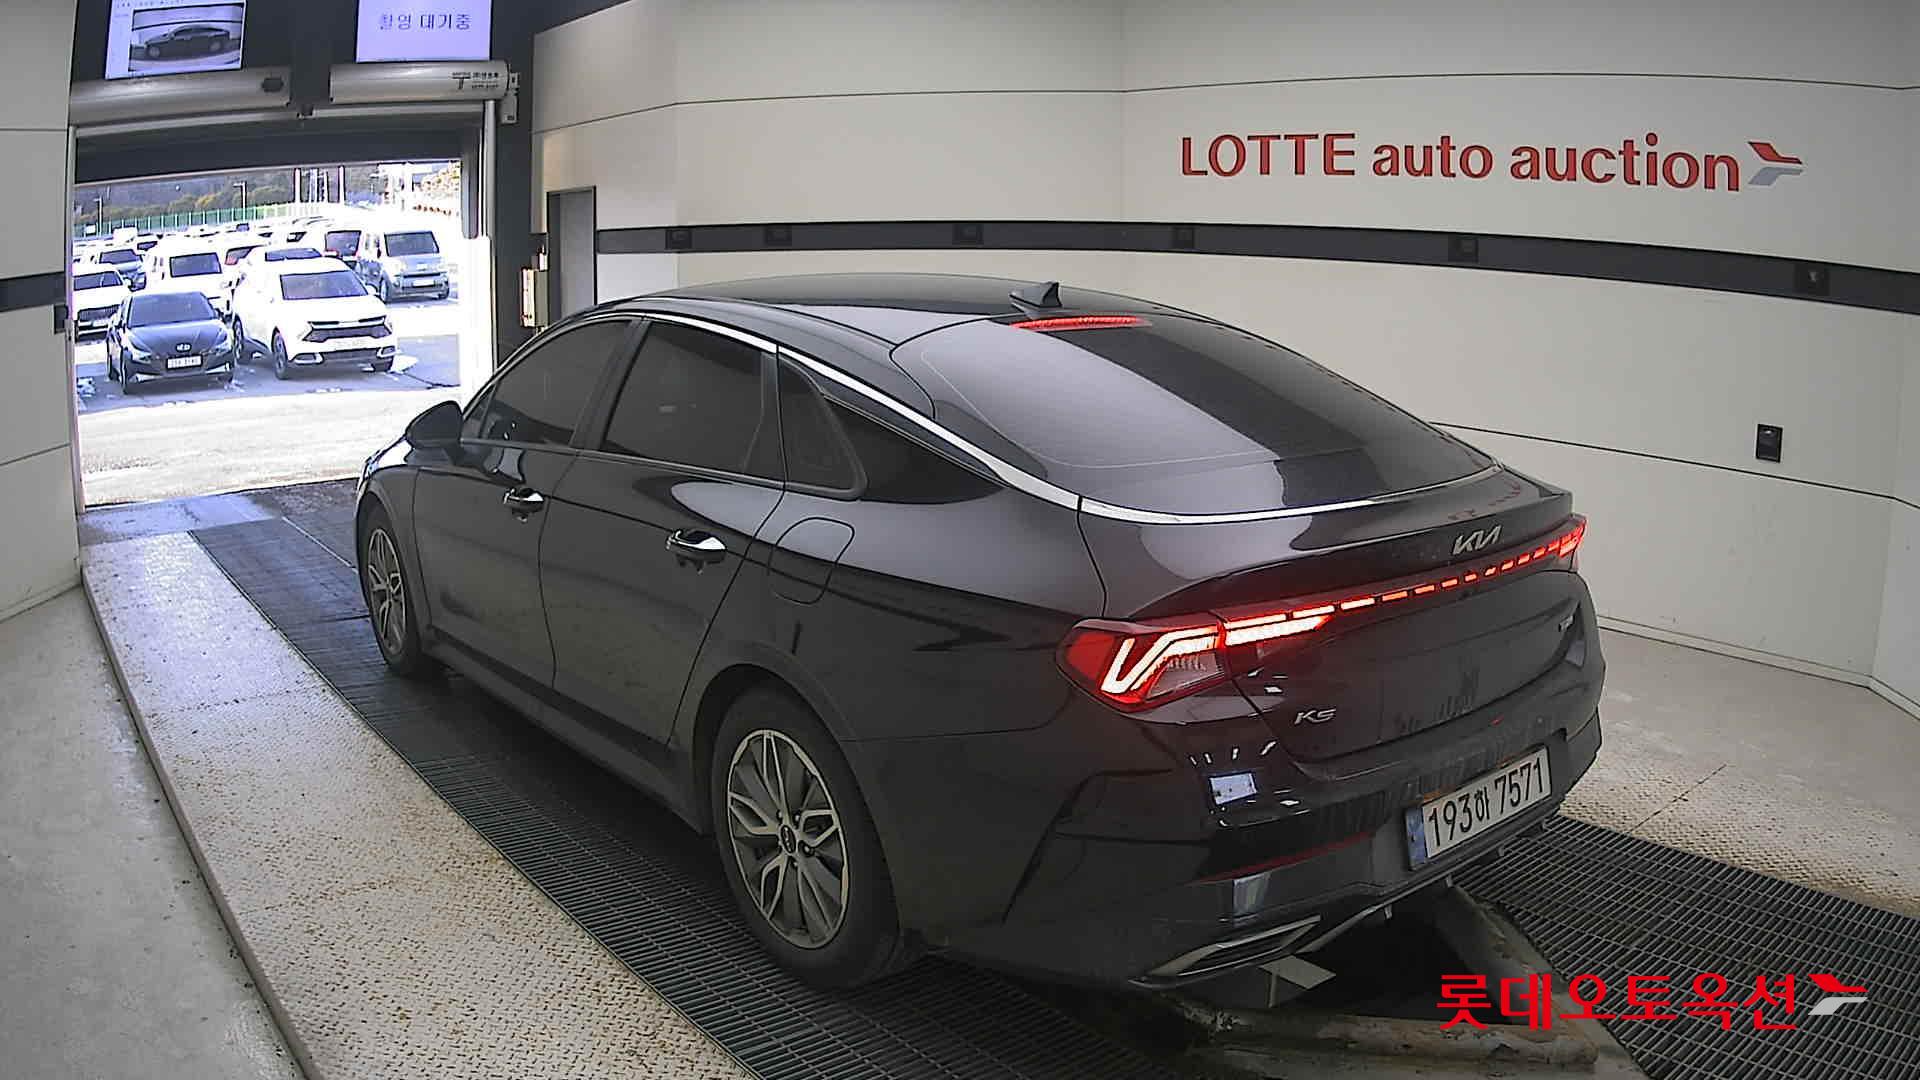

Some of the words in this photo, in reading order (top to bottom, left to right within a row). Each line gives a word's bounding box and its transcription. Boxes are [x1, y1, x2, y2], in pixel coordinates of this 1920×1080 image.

[420, 13, 471, 30] 대기중
[1181, 133, 1356, 177] LOTTE
[1373, 135, 1493, 179] auto
[1510, 134, 1740, 192] auction
[1294, 708, 1337, 725] K5
[1428, 786, 1490, 847] 193하
[1494, 757, 1543, 814] 7571
